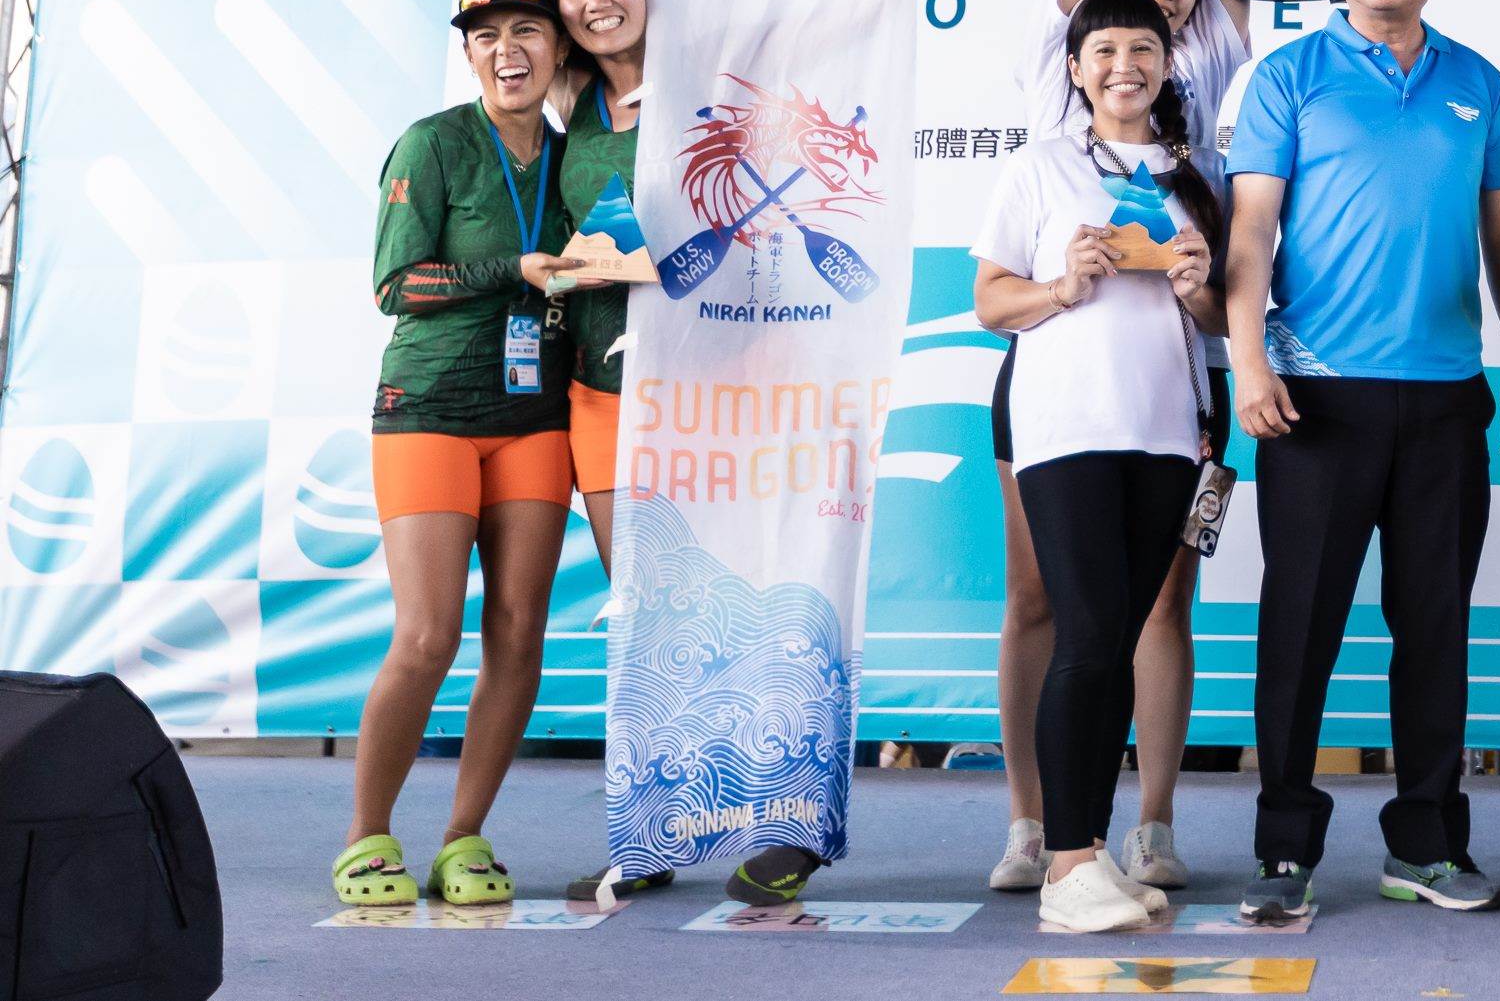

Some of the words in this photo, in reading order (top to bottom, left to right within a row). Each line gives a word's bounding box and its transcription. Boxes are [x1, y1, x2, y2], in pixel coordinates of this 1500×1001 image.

[672, 242, 704, 269] U.S.
[678, 248, 715, 288] NAVY
[825, 240, 874, 293] DRAGON
[818, 257, 859, 293] BOAT
[699, 301, 756, 322] NIRAI
[762, 303, 832, 324] KANAI
[817, 499, 847, 519] Est.
[761, 796, 820, 826] JAPAN
